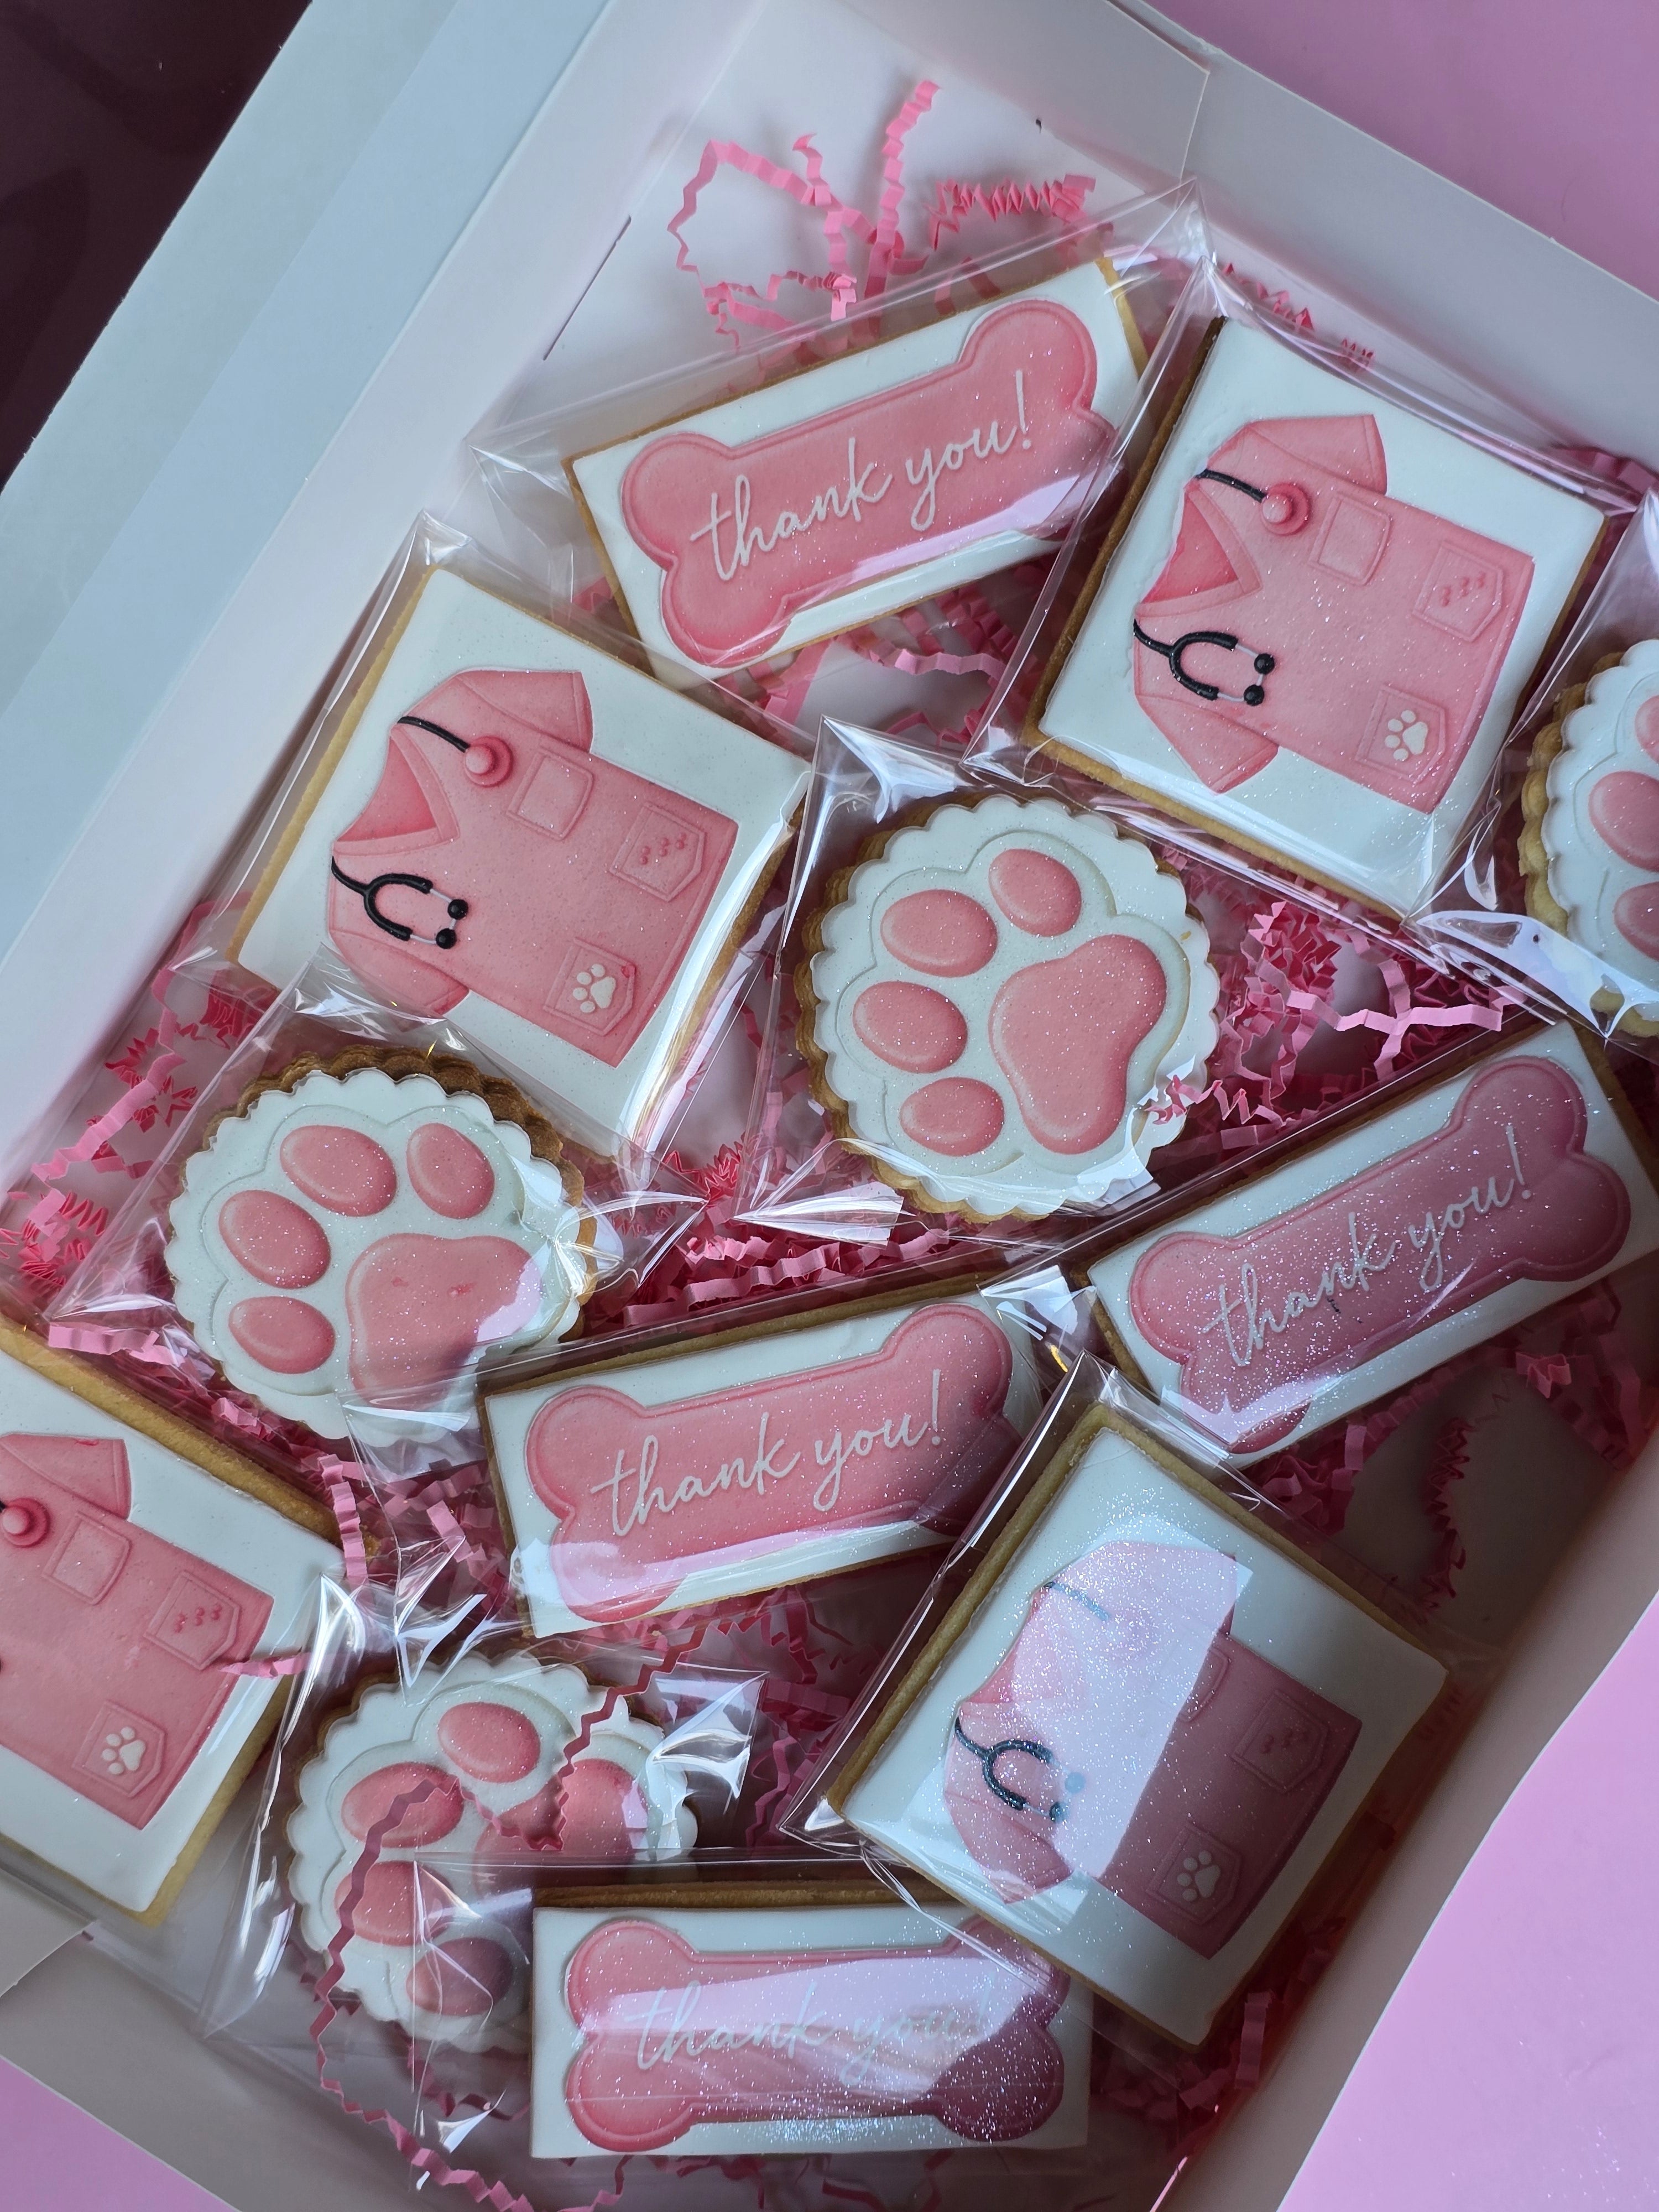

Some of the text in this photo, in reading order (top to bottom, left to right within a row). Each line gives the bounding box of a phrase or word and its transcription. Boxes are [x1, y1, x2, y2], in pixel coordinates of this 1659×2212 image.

[690, 370, 1031, 580] thank you!
[1202, 1125, 1531, 1366] thank you!
[591, 1369, 941, 1536] thank you!
[624, 1980, 838, 2071] thank
